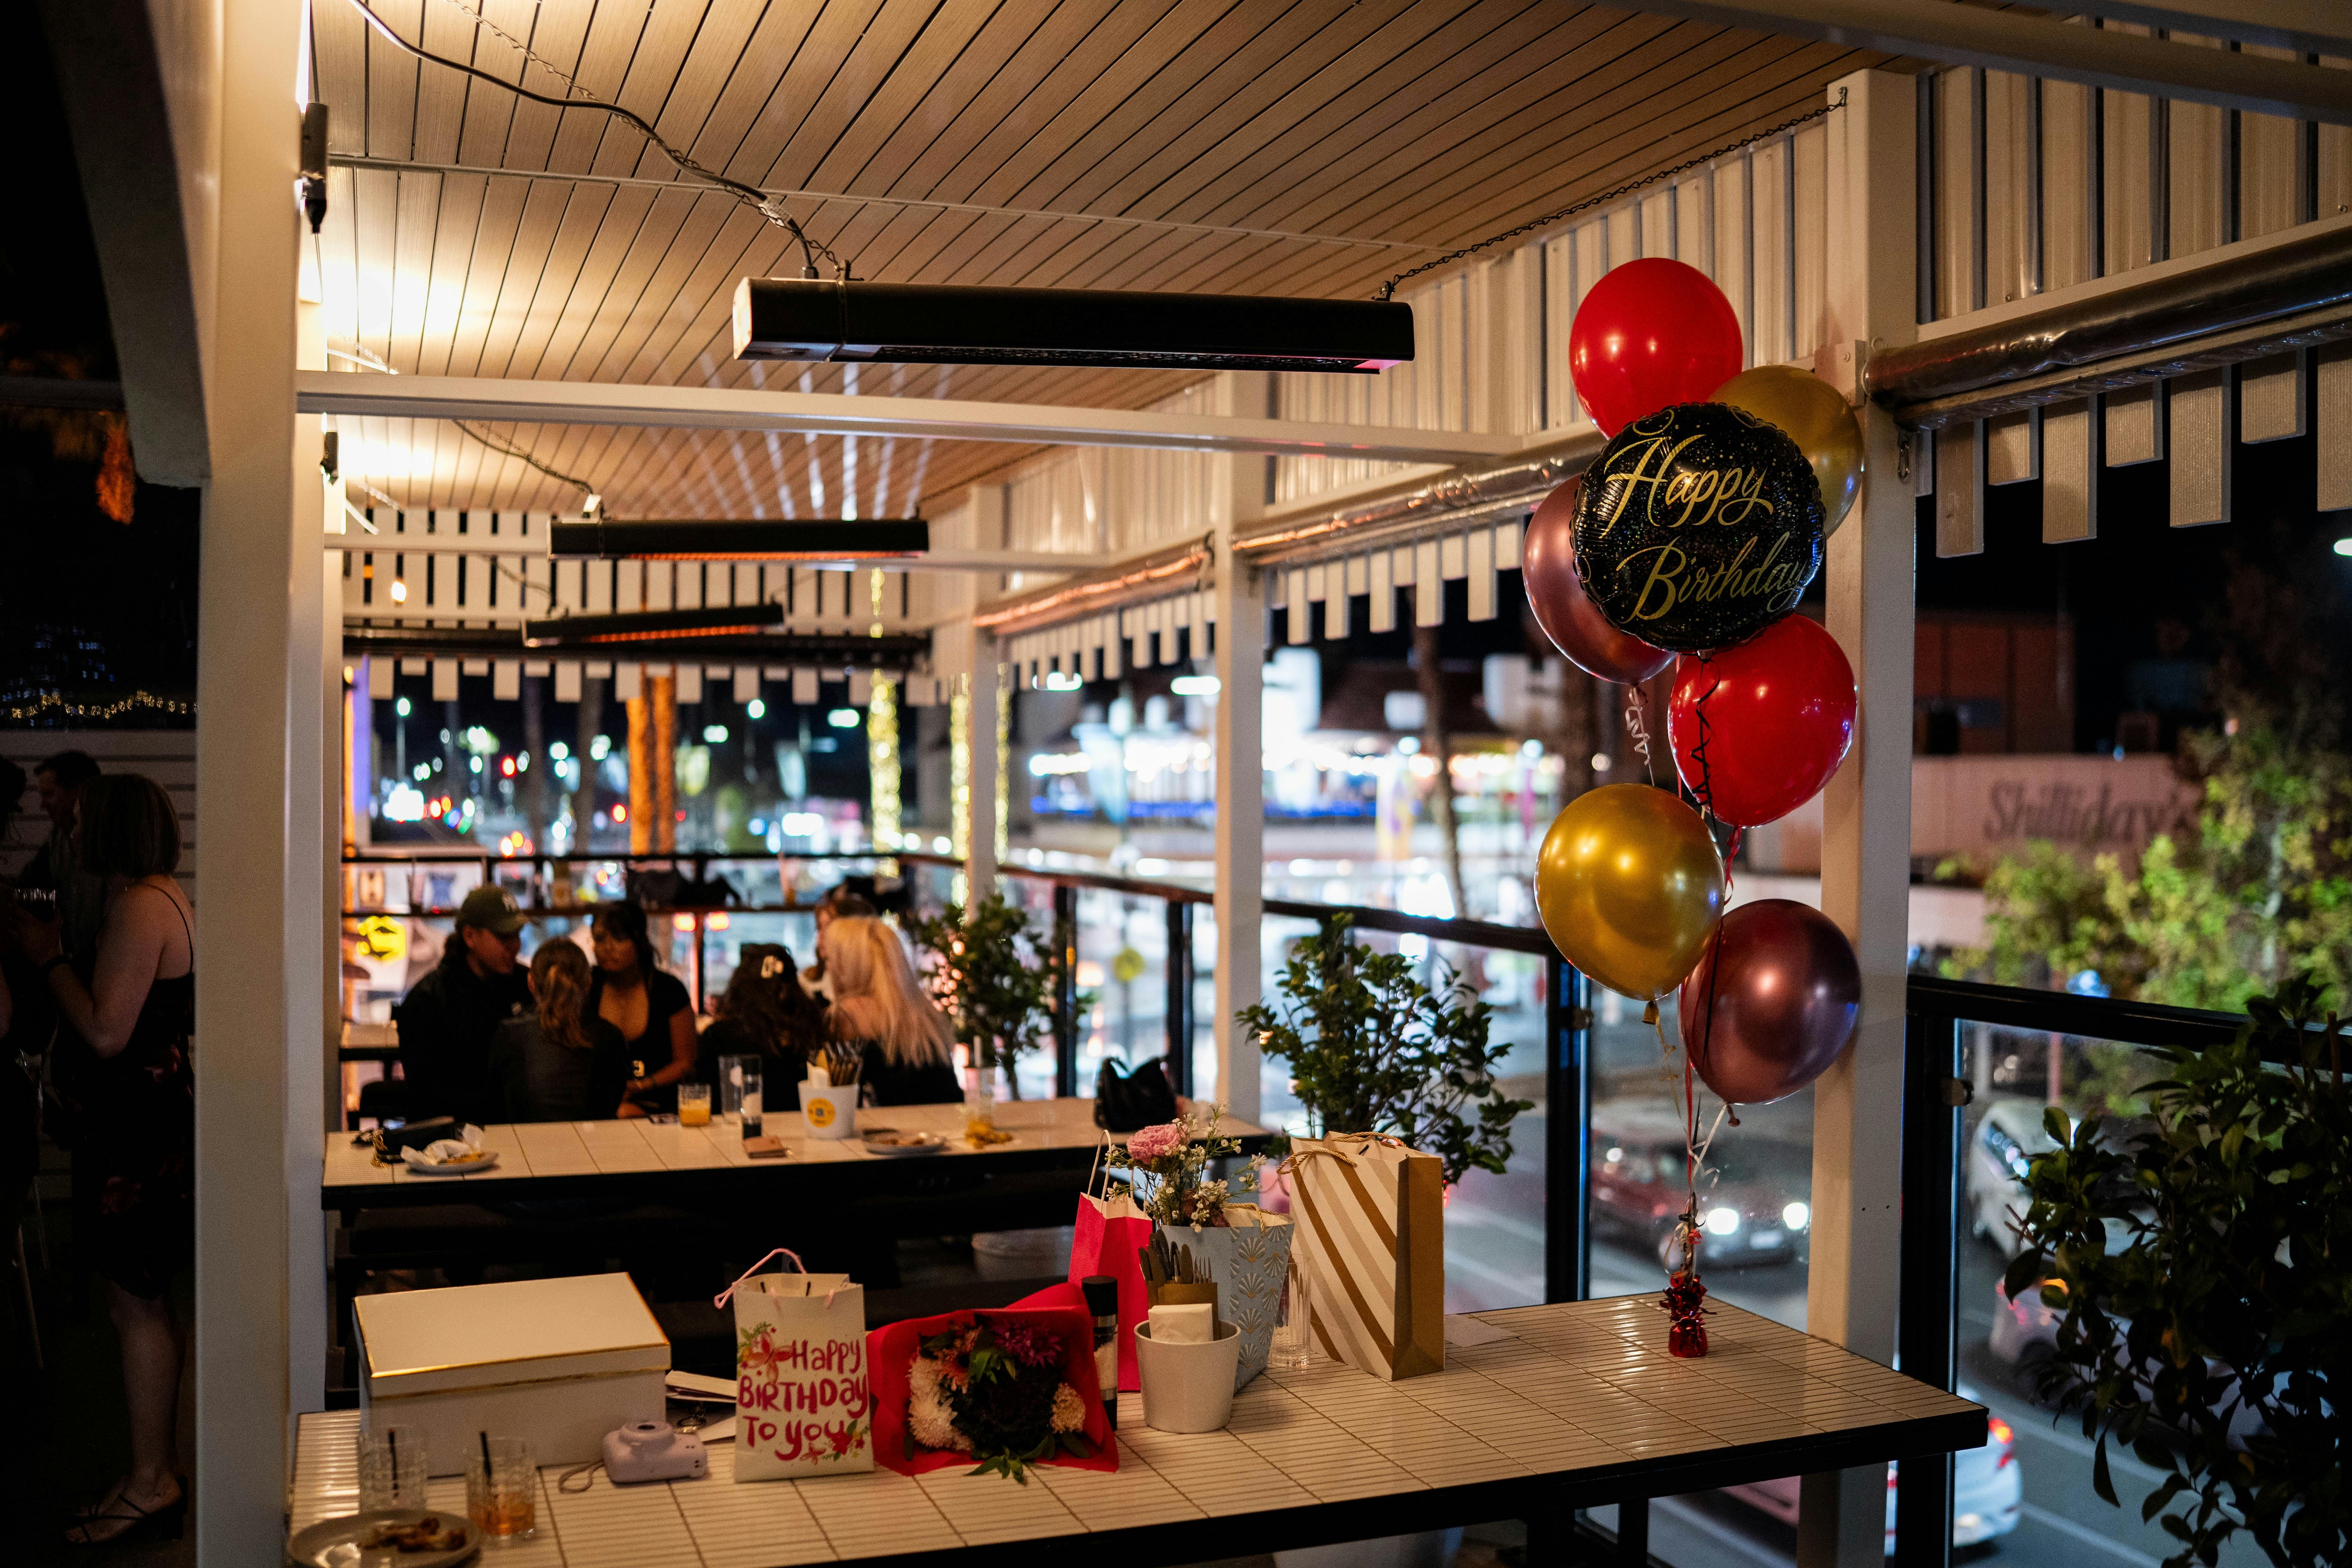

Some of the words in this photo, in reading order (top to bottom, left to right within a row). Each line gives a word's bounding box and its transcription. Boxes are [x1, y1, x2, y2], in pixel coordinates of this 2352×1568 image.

[1599, 434, 1774, 539] Happy
[1615, 531, 1808, 624] Birthday
[742, 1415, 777, 1448] To
